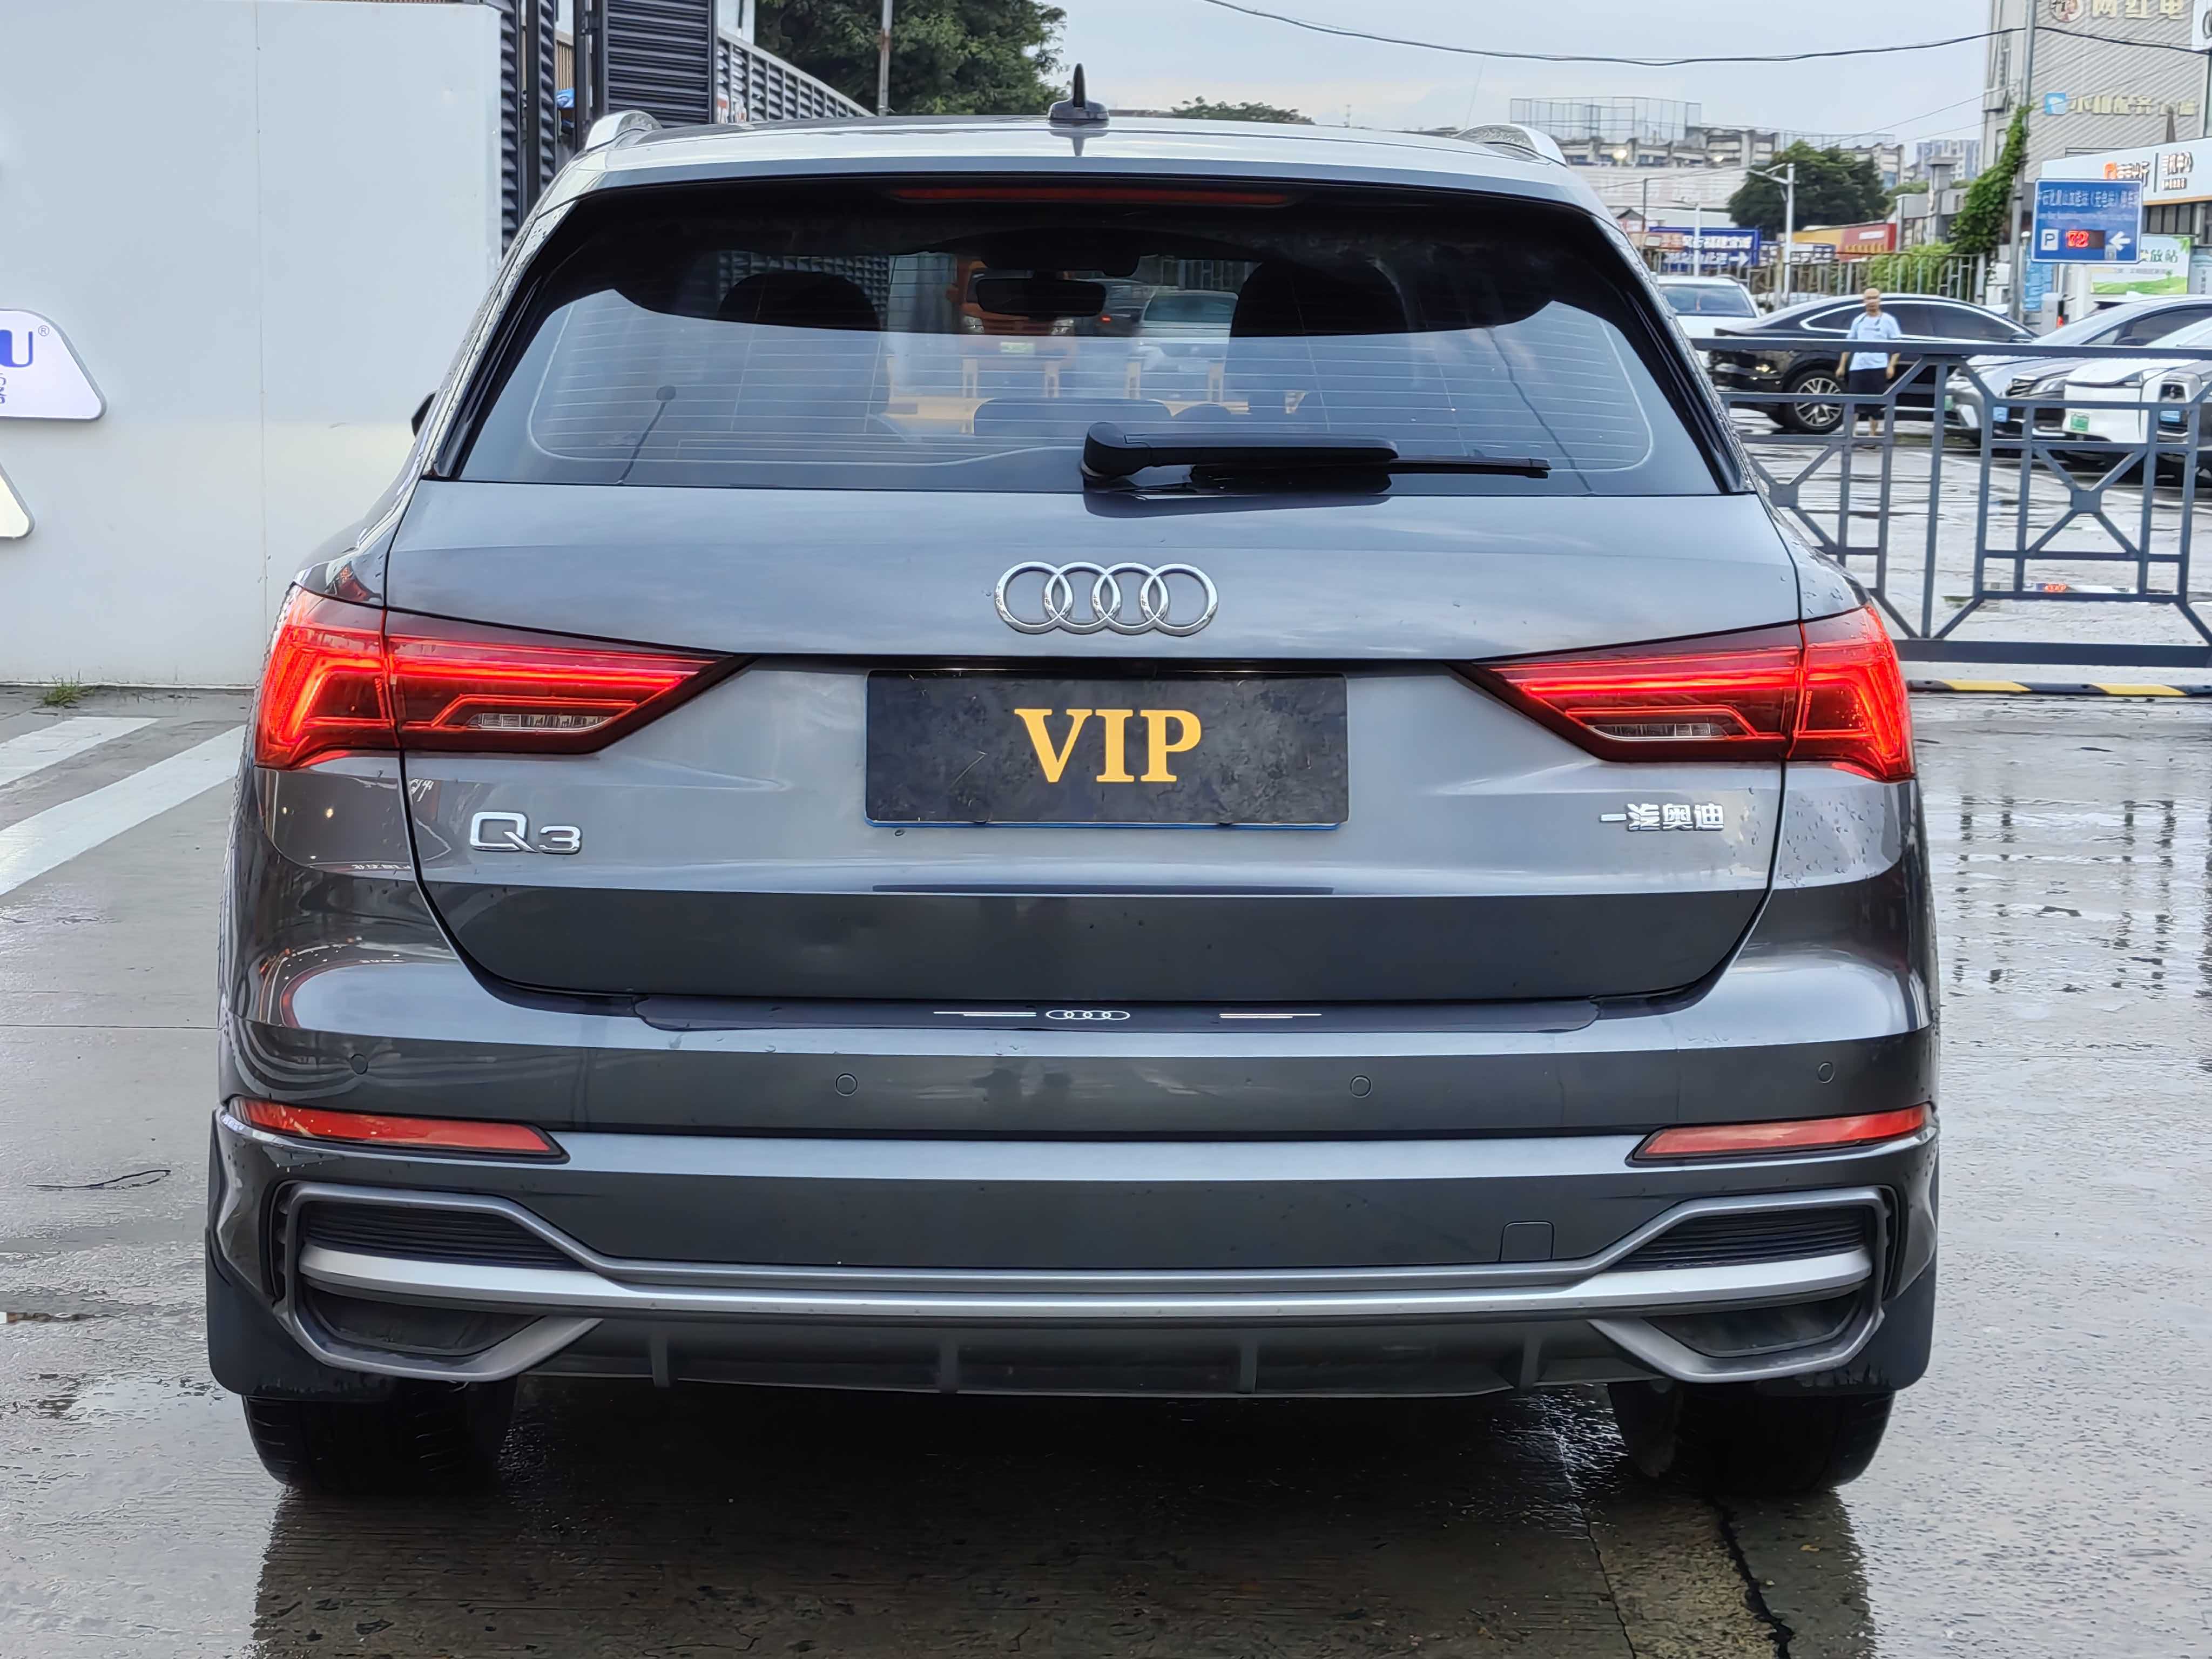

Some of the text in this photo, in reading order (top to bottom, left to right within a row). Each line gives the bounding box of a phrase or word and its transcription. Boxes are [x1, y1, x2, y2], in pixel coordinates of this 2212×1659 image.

[1014, 708, 1202, 783] VIP
[469, 811, 582, 854] Q3
[1600, 802, 1725, 831] 一汽奥迪
